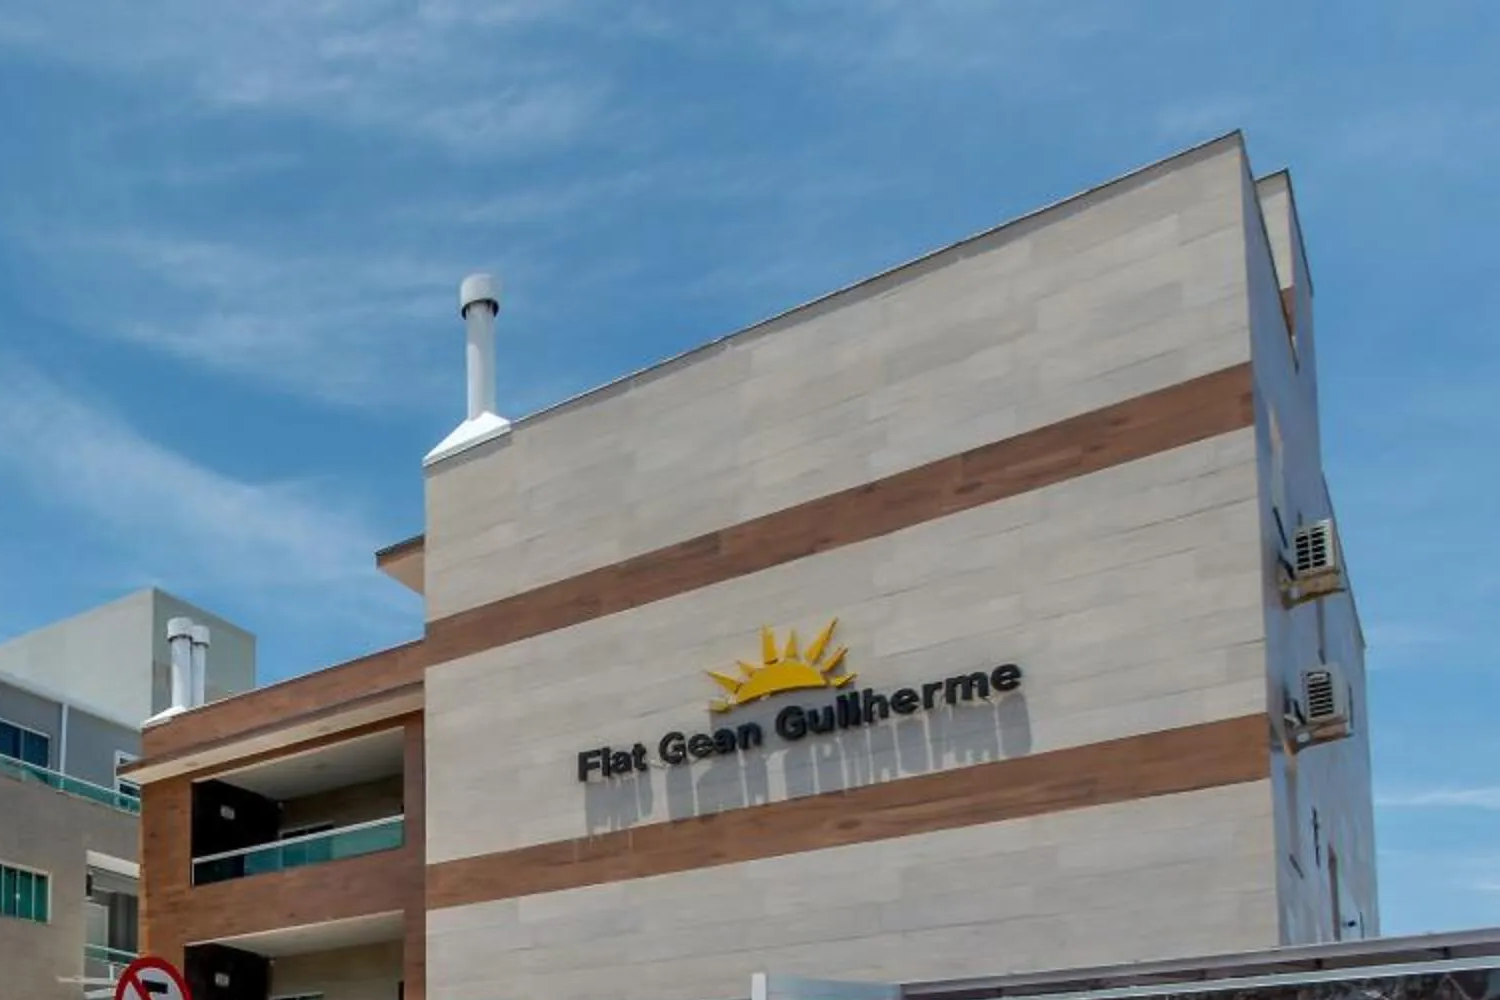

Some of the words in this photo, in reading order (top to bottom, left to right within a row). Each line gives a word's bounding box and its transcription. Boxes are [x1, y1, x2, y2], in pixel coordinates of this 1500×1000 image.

[578, 743, 648, 782] Flat
[659, 722, 762, 764] Gean
[775, 663, 1023, 741] Guilherme
